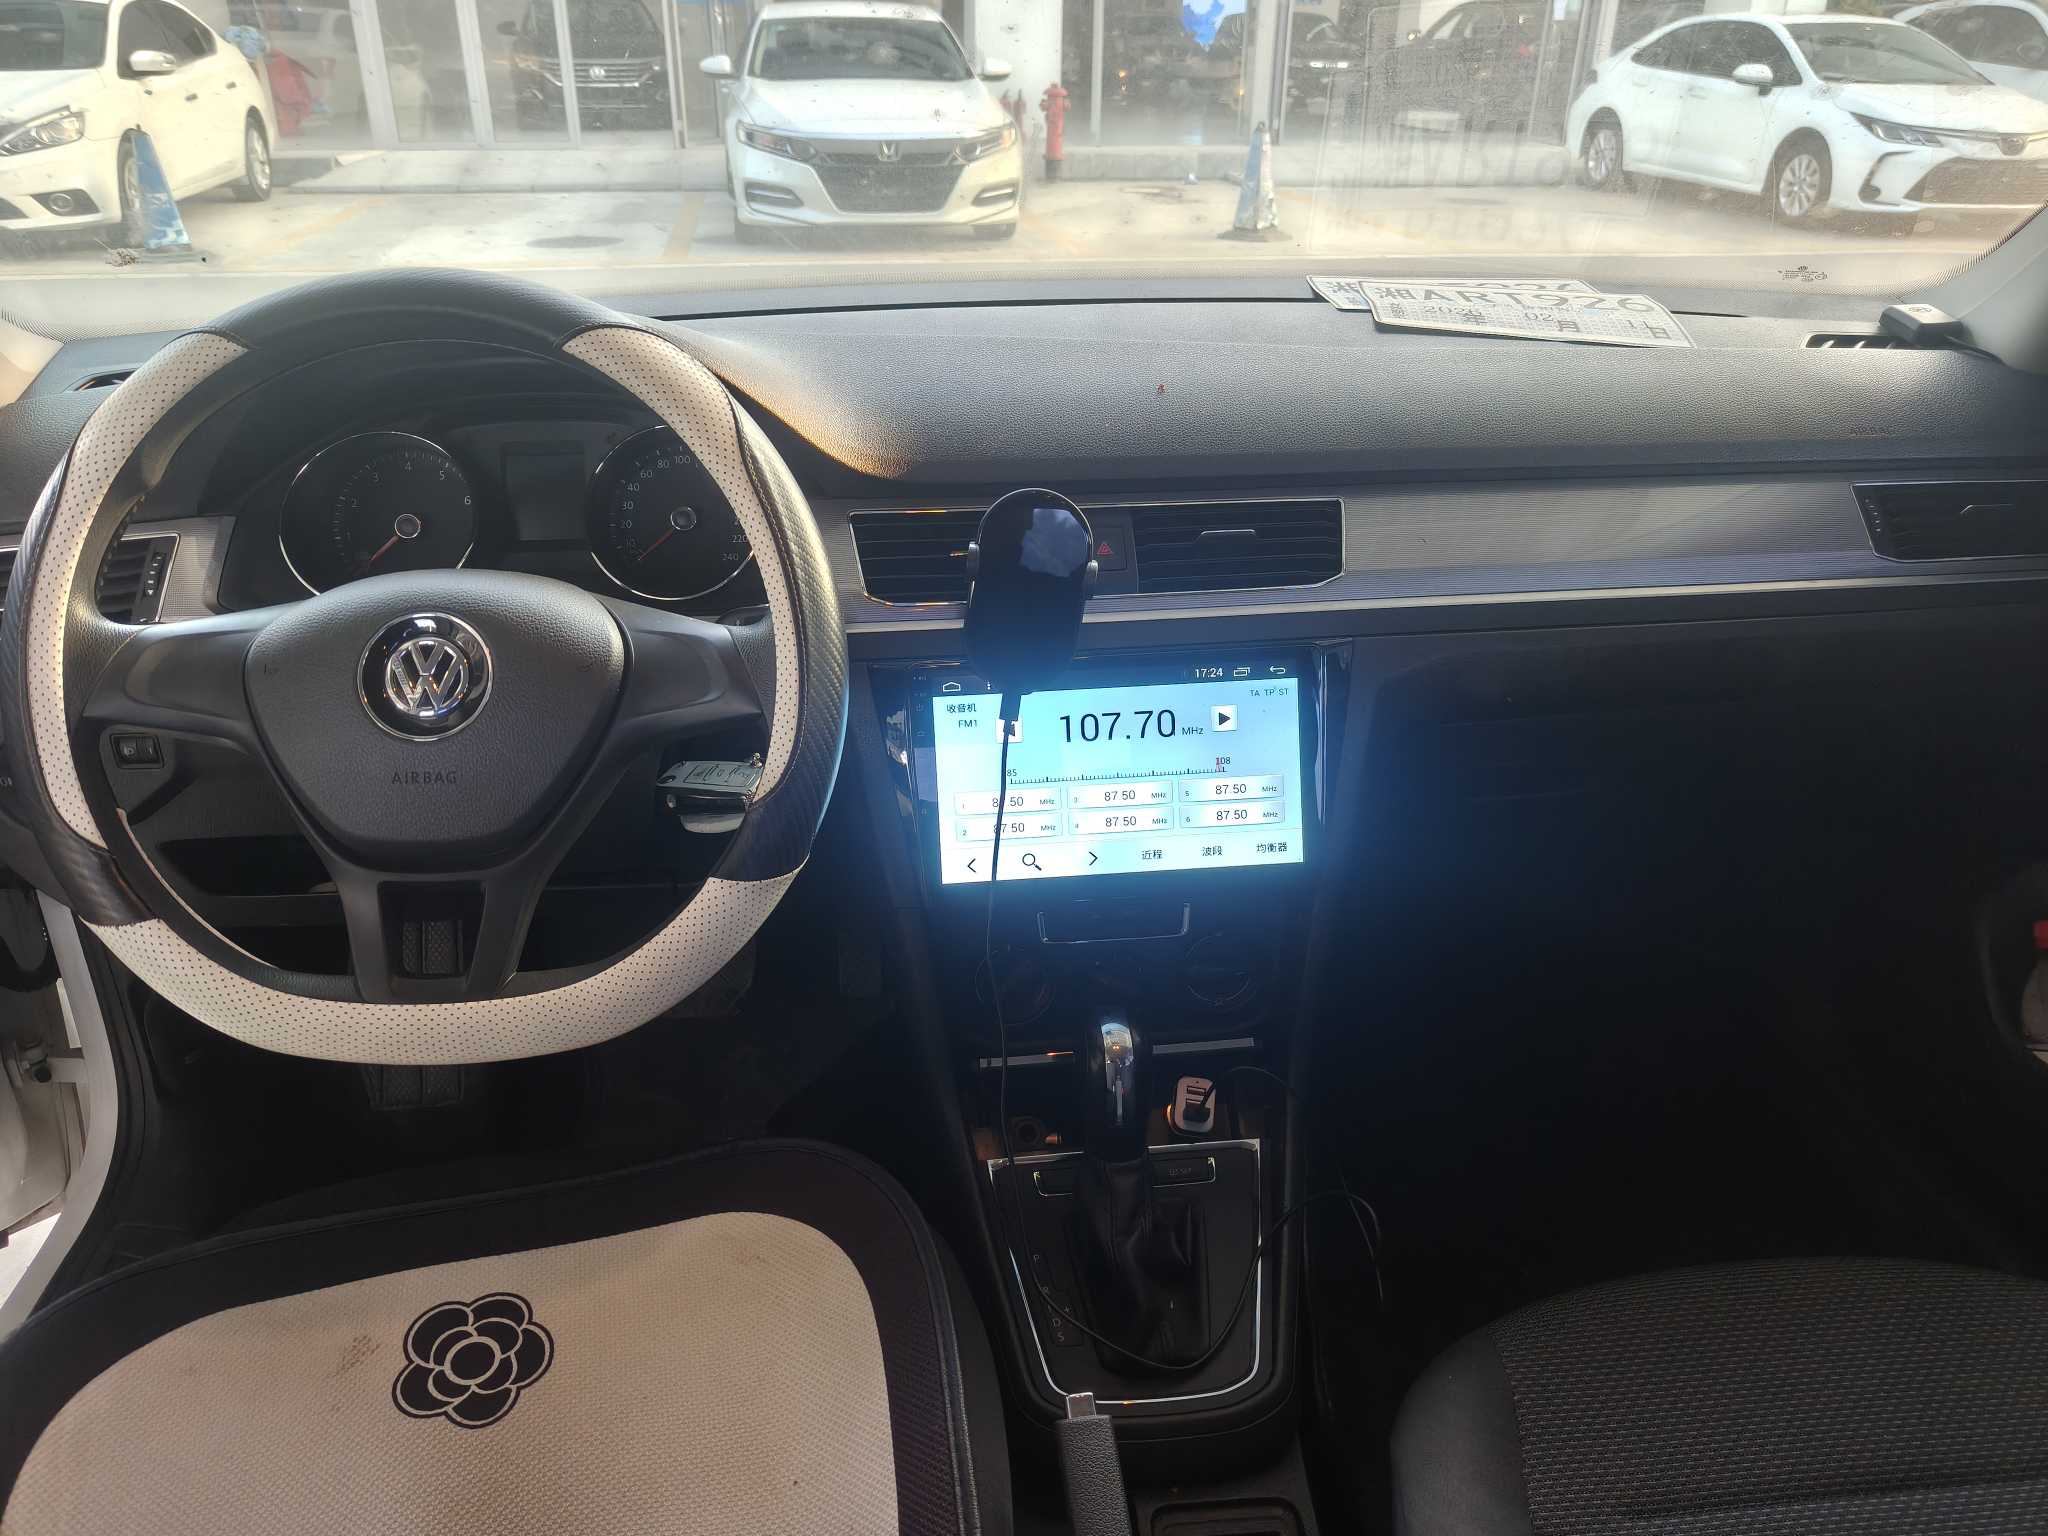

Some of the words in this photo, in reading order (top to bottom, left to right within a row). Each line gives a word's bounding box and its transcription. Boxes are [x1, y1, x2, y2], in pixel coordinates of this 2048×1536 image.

[657, 459, 669, 469] 80
[675, 455, 691, 465] 100
[439, 470, 446, 481] 5
[641, 470, 653, 479] 60
[627, 482, 640, 492] 40
[464, 495, 472, 505] 6
[1194, 667, 1224, 679] 17:24
[1249, 689, 1260, 698] TA
[1279, 687, 1289, 697] ST
[946, 702, 977, 714] 收音机
[958, 719, 978, 729] FM1
[1059, 709, 1176, 743] 107.70
[1181, 726, 1205, 736] MHz
[1216, 756, 1231, 766] 108
[391, 771, 457, 785] AIRBAG
[1006, 768, 1018, 778] 85
[1215, 783, 1247, 795] 87.50
[1262, 785, 1278, 793] MHz
[1104, 789, 1137, 802] 87.50
[1151, 791, 1167, 800] MHz
[992, 795, 1025, 808] 8.50
[1216, 809, 1248, 821] 87.50
[1263, 810, 1279, 819] MHz
[1105, 815, 1138, 828] 87.50
[1152, 817, 1168, 826] MHz
[1202, 845, 1223, 857] 波段
[1256, 842, 1288, 854] 均衡器
[1141, 850, 1163, 861] 近程
